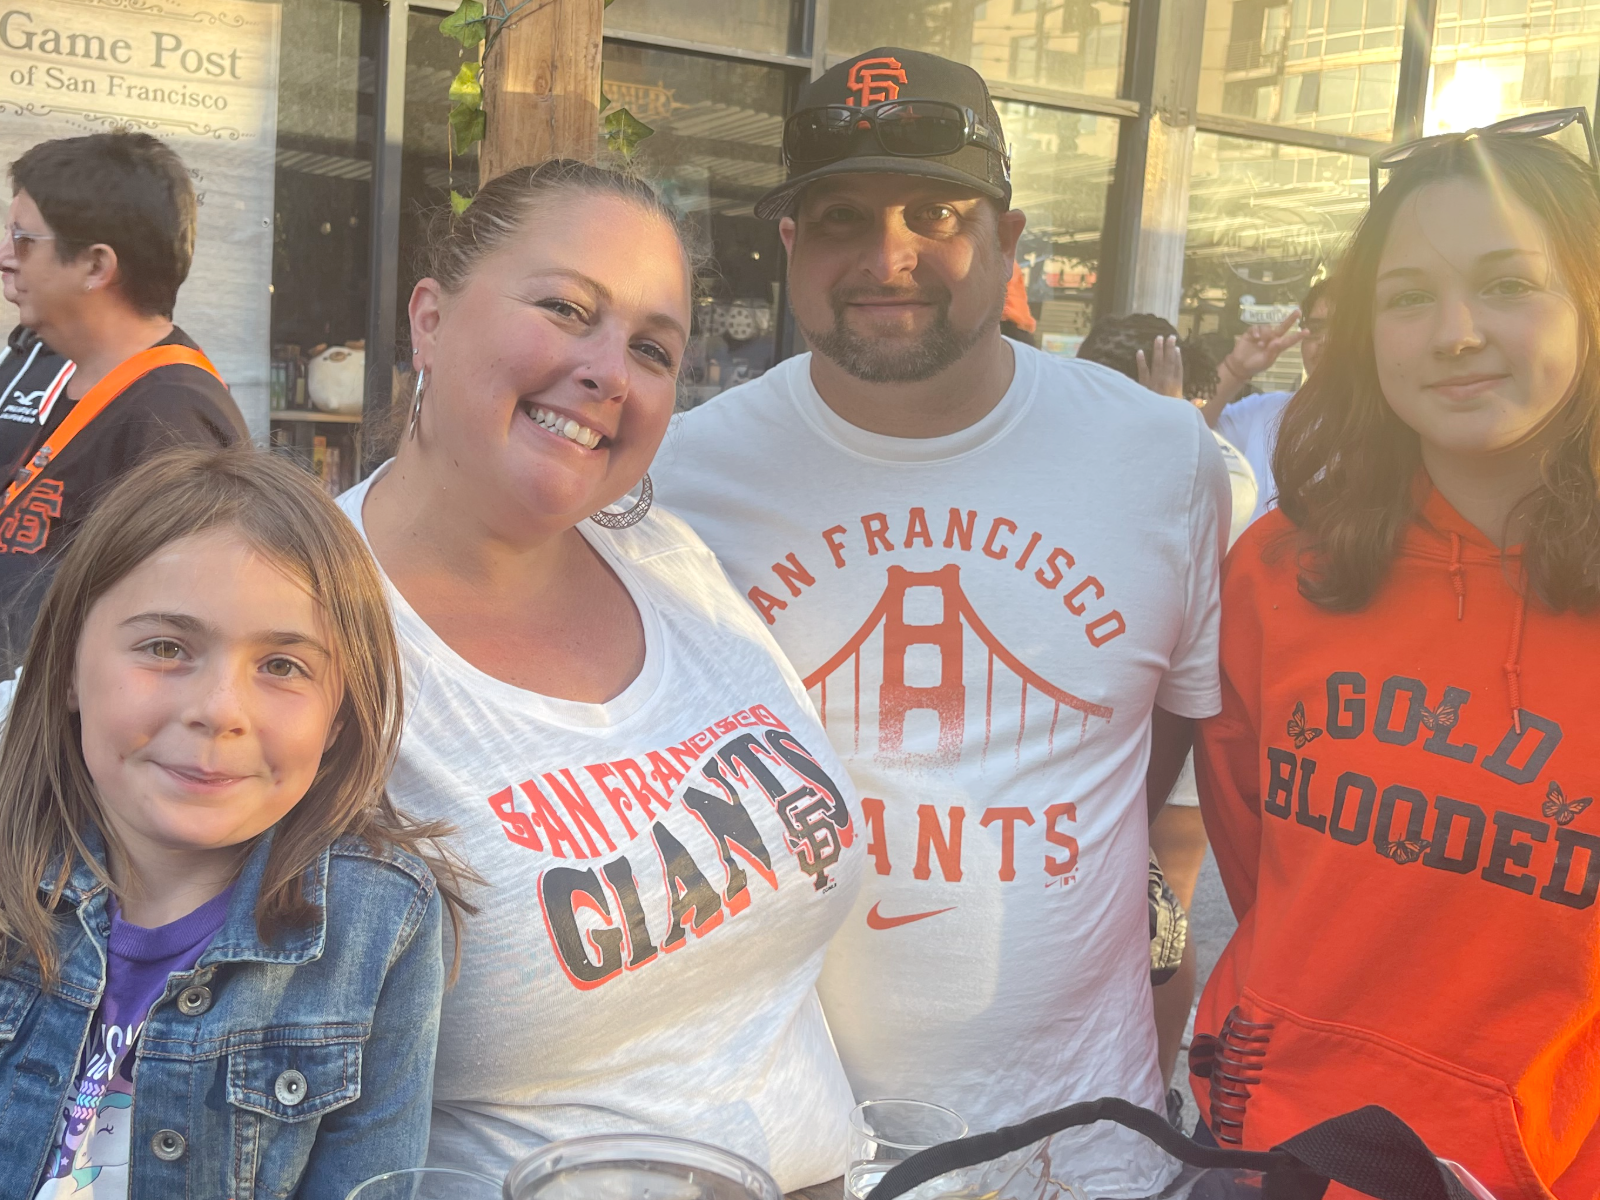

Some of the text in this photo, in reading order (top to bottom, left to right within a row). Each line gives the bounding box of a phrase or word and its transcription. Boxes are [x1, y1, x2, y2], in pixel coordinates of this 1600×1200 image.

[0, 9, 242, 80] Game Post
[10, 65, 228, 110] of San Francisco
[746, 506, 1127, 648] AN FRANCISCO
[487, 703, 791, 859] SAN FRANCISCO
[1326, 671, 1564, 785] GOLD
[536, 729, 853, 991] GIANTS
[860, 797, 1079, 883] ANTS
[1264, 746, 1600, 910] BLOODED
